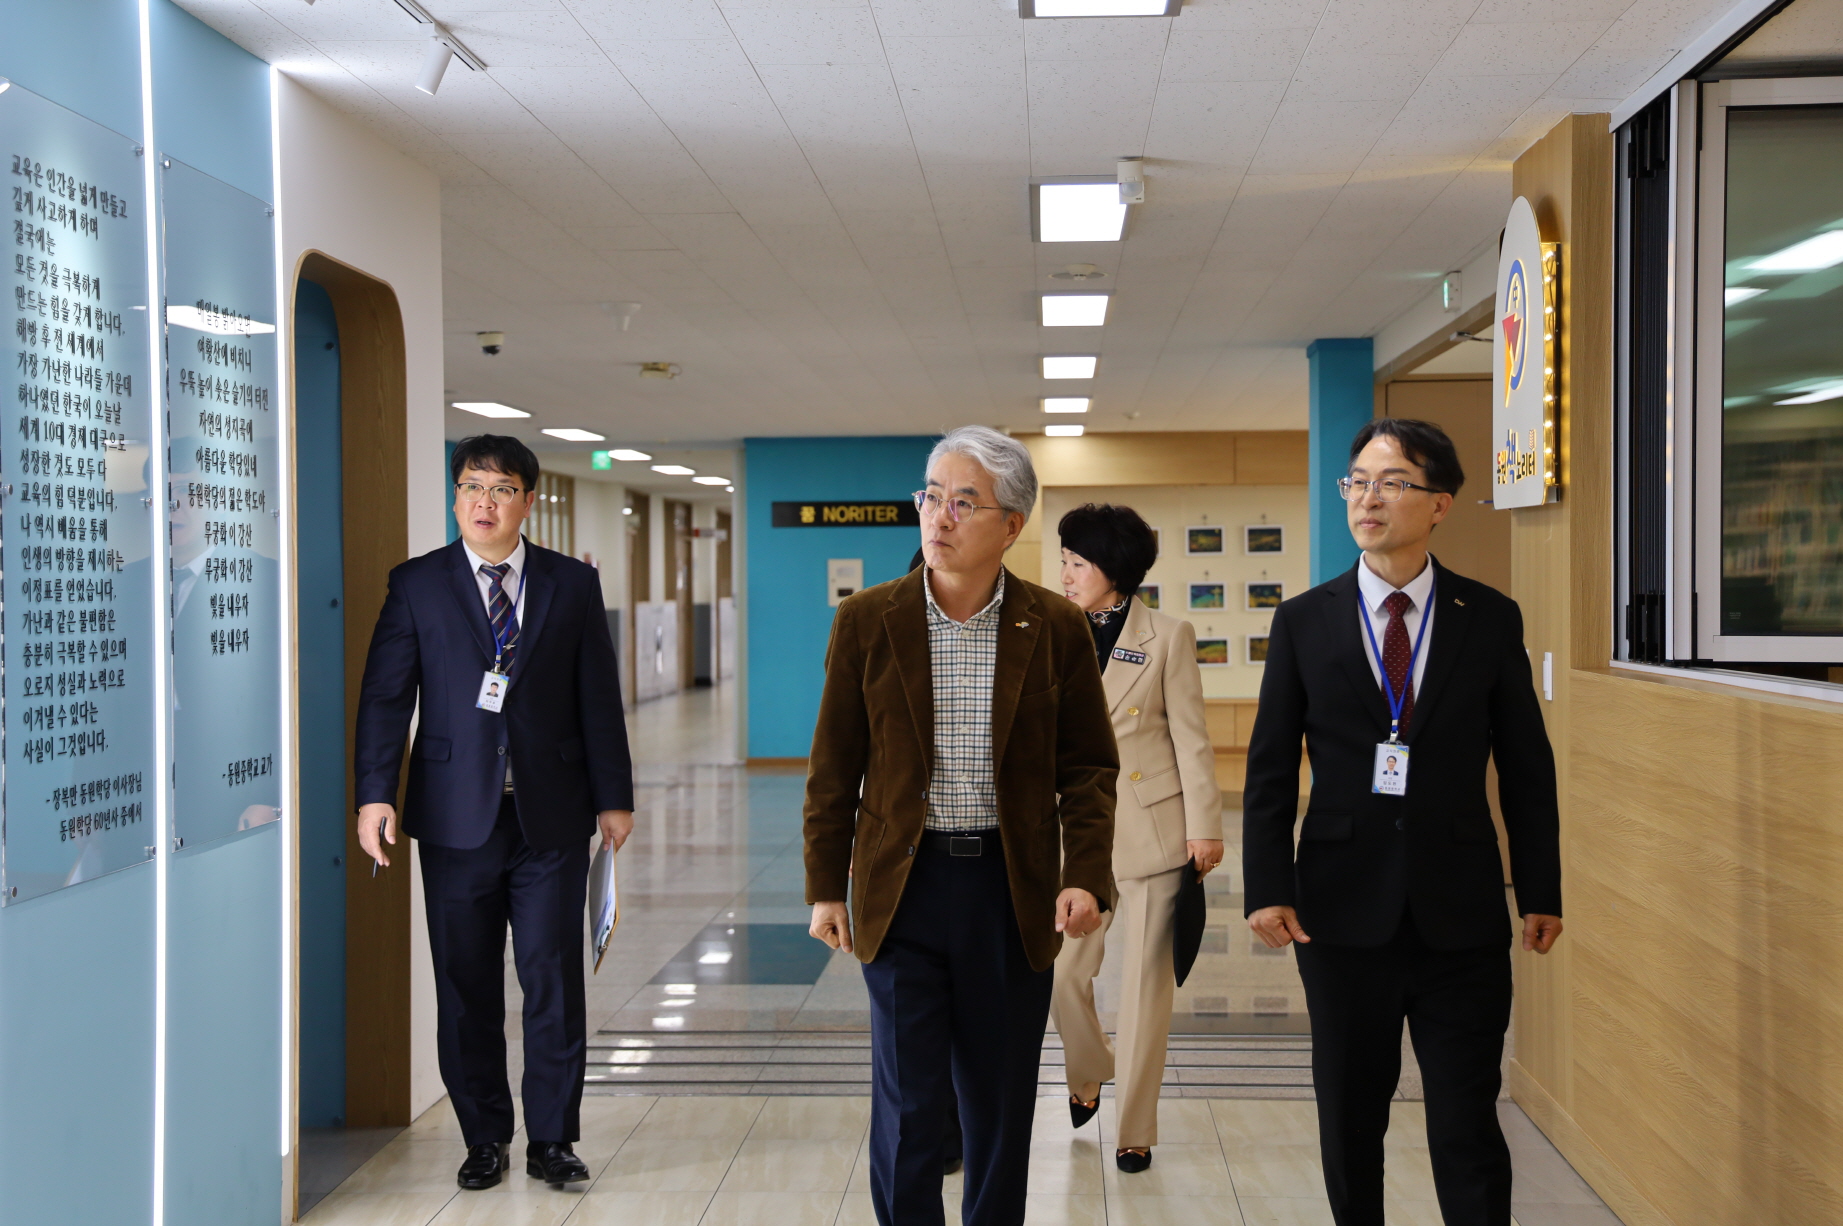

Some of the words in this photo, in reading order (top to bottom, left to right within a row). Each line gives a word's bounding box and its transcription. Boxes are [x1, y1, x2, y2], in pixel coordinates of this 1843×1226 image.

[11, 153, 44, 188] 교육은
[46, 167, 77, 202] 인간을
[79, 181, 99, 210] 넓게
[99, 190, 128, 219] 만들고
[13, 185, 34, 217] 깊게
[37, 195, 78, 233] 사고하게
[80, 212, 99, 241] 하며
[13, 218, 56, 256] 결국에는
[14, 253, 36, 282] 모든
[39, 259, 59, 290] 것을
[61, 267, 101, 302] 극복하게
[15, 284, 48, 318] 만드는
[51, 294, 71, 324] 힘을
[73, 301, 92, 330] 갖게
[95, 307, 126, 337] 합니다.
[16, 317, 38, 347] 해방
[40, 323, 52, 350] 후
[54, 327, 64, 353] 전
[66, 330, 105, 362] 세계에서
[17, 350, 39, 380] 가장
[41, 356, 72, 386] 가난한
[74, 363, 103, 393] 나라들
[105, 370, 133, 398] 가운데
[229, 344, 252, 374] 비치니
[18, 382, 60, 416] 하나였던
[62, 391, 92, 421] 한국이
[94, 400, 123, 426] 오늘날
[179, 368, 197, 396] 우뚝
[197, 372, 214, 400] 높이
[215, 376, 231, 405] 솟은
[231, 380, 254, 408] 슬기의
[254, 386, 270, 412] 터전
[19, 415, 40, 444] 세계
[43, 419, 65, 448] 10대
[67, 423, 87, 451] 경제
[89, 427, 127, 453] 대국으로
[199, 409, 223, 438] 자연의
[19, 448, 52, 477] 성장한
[54, 452, 75, 479] 것도
[195, 445, 227, 475] 아름다운
[20, 482, 52, 508] 교육의
[54, 483, 65, 510] 힘
[67, 485, 118, 514] 덕분입니다.
[188, 482, 226, 511] 동원학당의
[228, 486, 244, 512] 젊은
[244, 488, 267, 513] 학도야
[20, 512, 33, 539] 나
[34, 513, 55, 541] 역시
[57, 516, 88, 542] 배움을
[89, 518, 109, 543] 통해
[822, 505, 899, 524] NORITER
[204, 520, 228, 547] 무궁화
[229, 521, 237, 548] 이
[238, 522, 253, 548] 강산
[22, 545, 53, 573] 인생의
[55, 546, 86, 574] 방향을
[87, 548, 125, 573] 제시하는
[205, 557, 228, 584] 무궁화
[229, 557, 237, 583] 이
[238, 557, 253, 584] 강산
[22, 577, 64, 604] 이정표를
[66, 577, 117, 603] 얻었습니다.
[210, 592, 226, 620] 빛을
[226, 592, 250, 619] 내우자
[22, 609, 54, 635] 가난과
[56, 609, 77, 634] 같은
[78, 608, 117, 634] 불편함은
[22, 640, 54, 668] 충분히
[56, 639, 87, 666] 극복할
[88, 639, 99, 663] 수
[100, 637, 128, 663] 있으며
[210, 629, 226, 657] 빛을
[227, 627, 250, 654] 내우자
[23, 672, 54, 698] 오로지
[57, 670, 87, 697] 성실과
[88, 668, 126, 693] 노력으로
[23, 704, 55, 733] 이겨낼
[57, 704, 68, 728] 수
[70, 700, 99, 727] 있다는
[23, 735, 55, 765] 사실이
[57, 728, 109, 759] 그것입니다.
[227, 757, 260, 788] 동원중학교
[260, 753, 273, 777] 교가
[52, 784, 78, 812] 장복만
[79, 777, 112, 806] 동원학당
[112, 770, 143, 798] 이사장님
[59, 812, 93, 843] 동원학당
[93, 806, 120, 831] 60년사
[120, 801, 142, 828] 중에서
